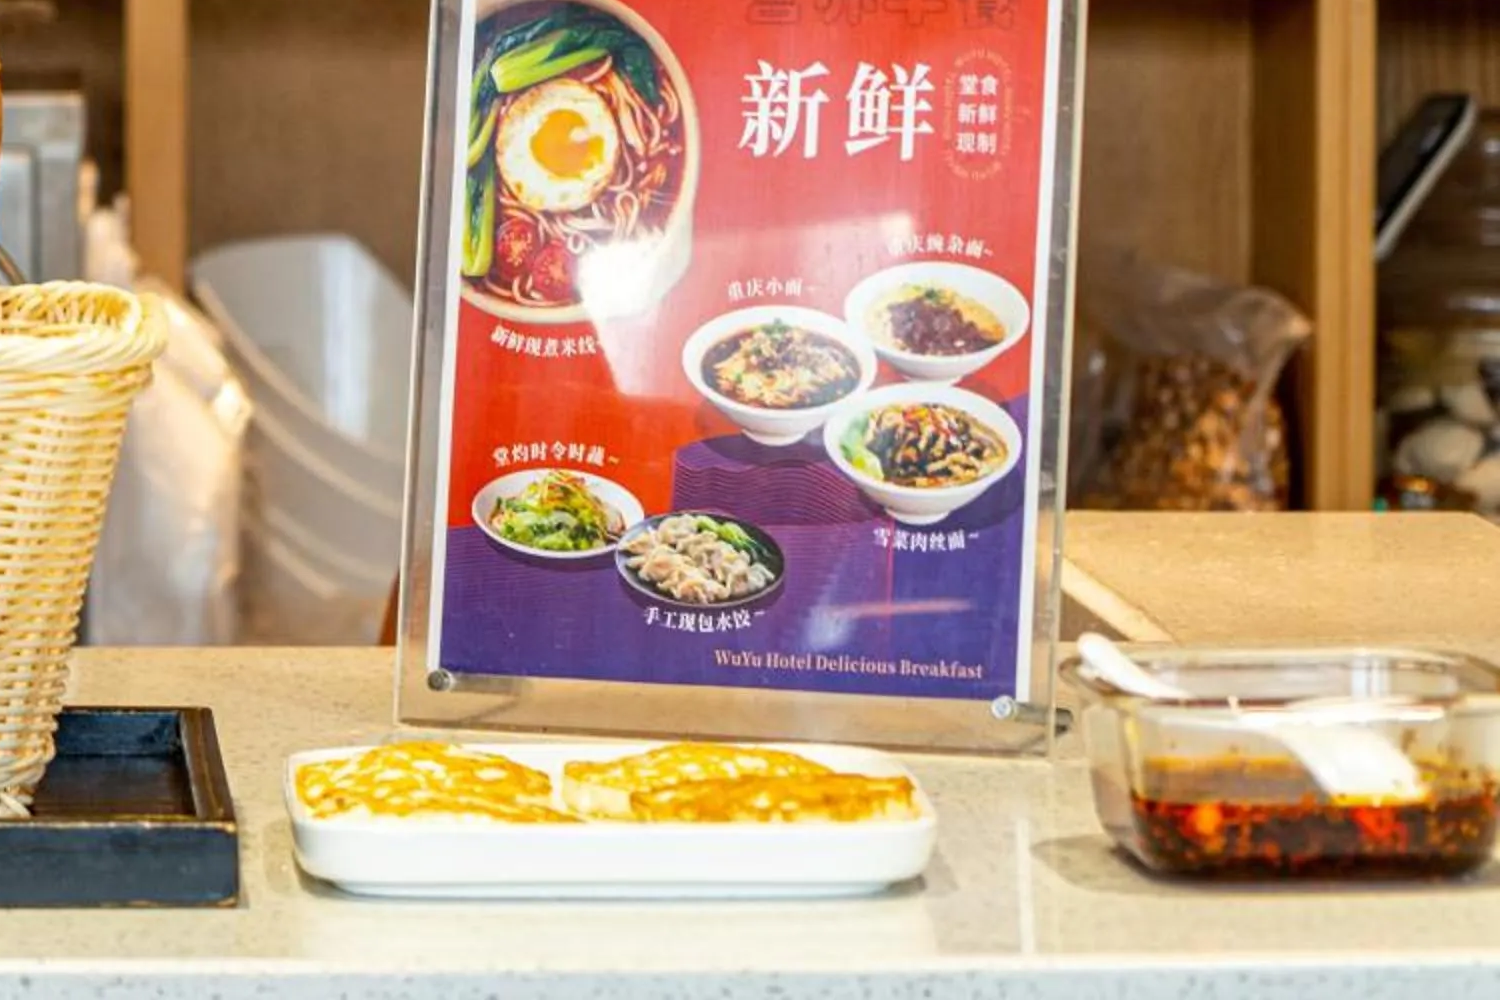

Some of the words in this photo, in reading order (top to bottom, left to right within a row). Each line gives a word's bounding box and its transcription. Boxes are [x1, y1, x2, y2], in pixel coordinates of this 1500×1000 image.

[737, 59, 936, 161] 新鲜
[714, 650, 762, 668] WuYu
[766, 651, 812, 671] Hotel
[816, 654, 896, 676] Delicious
[900, 659, 982, 680] Breakfast
